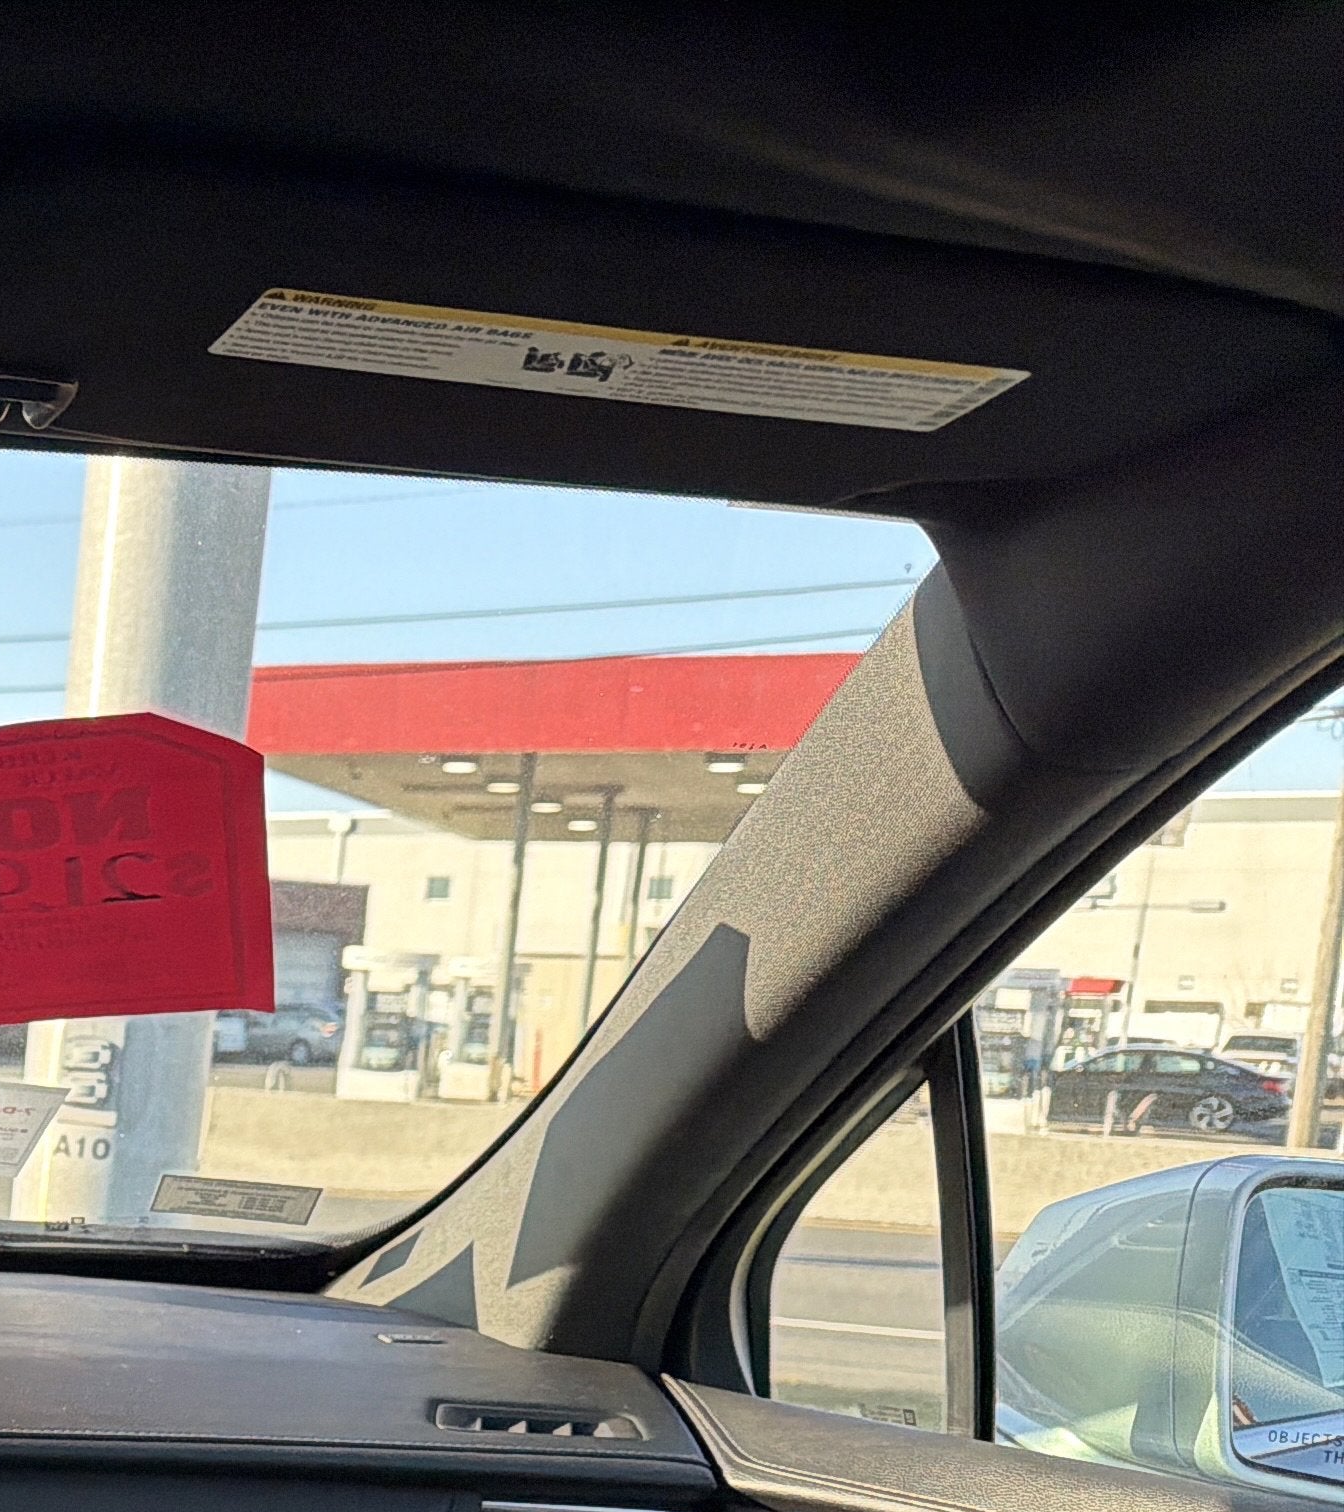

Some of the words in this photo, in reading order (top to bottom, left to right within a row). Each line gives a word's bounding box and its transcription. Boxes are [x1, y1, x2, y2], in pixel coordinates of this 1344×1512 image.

[292, 294, 376, 311] WARNING
[257, 301, 304, 315] EVEN
[307, 307, 353, 320] WITH
[355, 312, 449, 331] ADVANCED
[451, 323, 483, 335] AIR
[486, 328, 534, 341] BAGS
[52, 1134, 111, 1161] A10
[1268, 1430, 1343, 1446] OBJECTS
